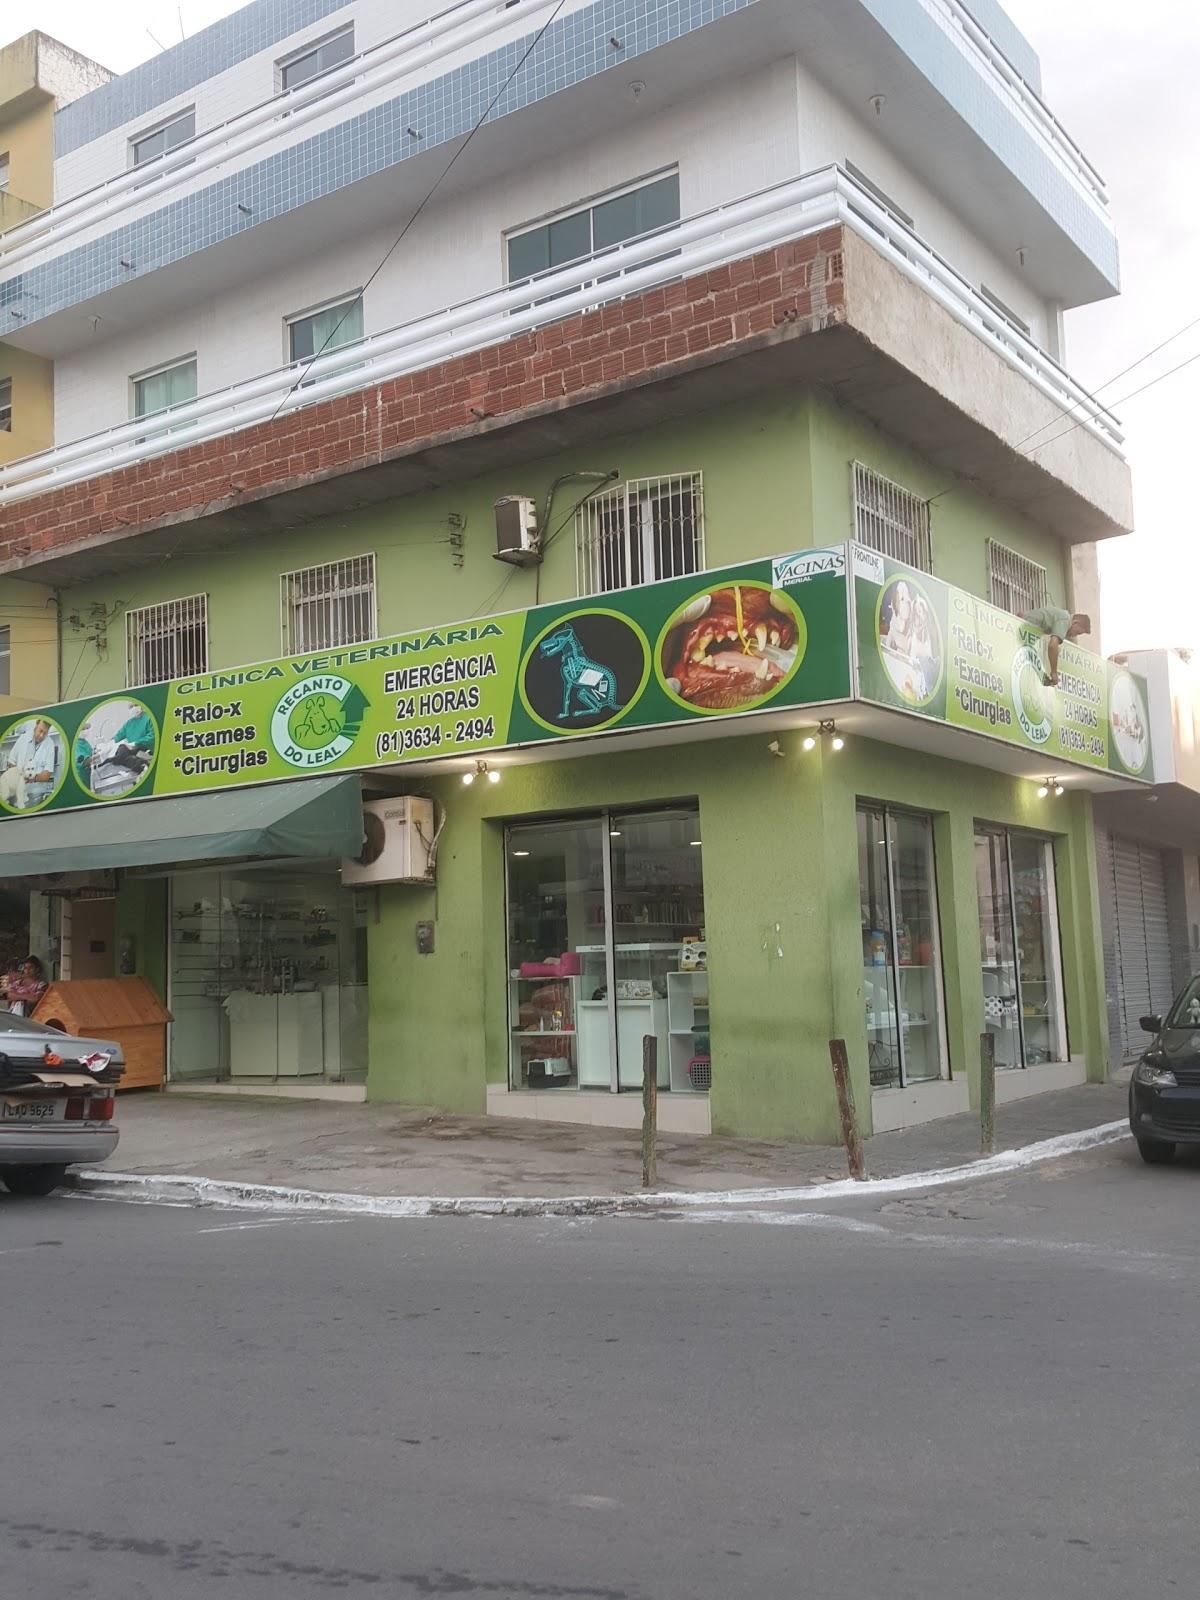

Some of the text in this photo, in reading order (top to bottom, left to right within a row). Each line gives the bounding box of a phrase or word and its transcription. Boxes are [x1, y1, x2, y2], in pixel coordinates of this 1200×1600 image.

[773, 554, 846, 582] VACINAS
[784, 576, 813, 586] MERIAL
[176, 623, 505, 696] CLÍNICA VETERINÁRIA
[384, 654, 497, 693] EMERGÊNCIA
[277, 678, 343, 715] RECANTO
[397, 686, 479, 719] 24 HORAS
[1064, 700, 1098, 728] 24 HORAS
[376, 725, 441, 758] (81)3634
[456, 716, 495, 742] 2494
[1031, 725, 1048, 741] LEAL
[283, 746, 342, 764] DO LEAL
